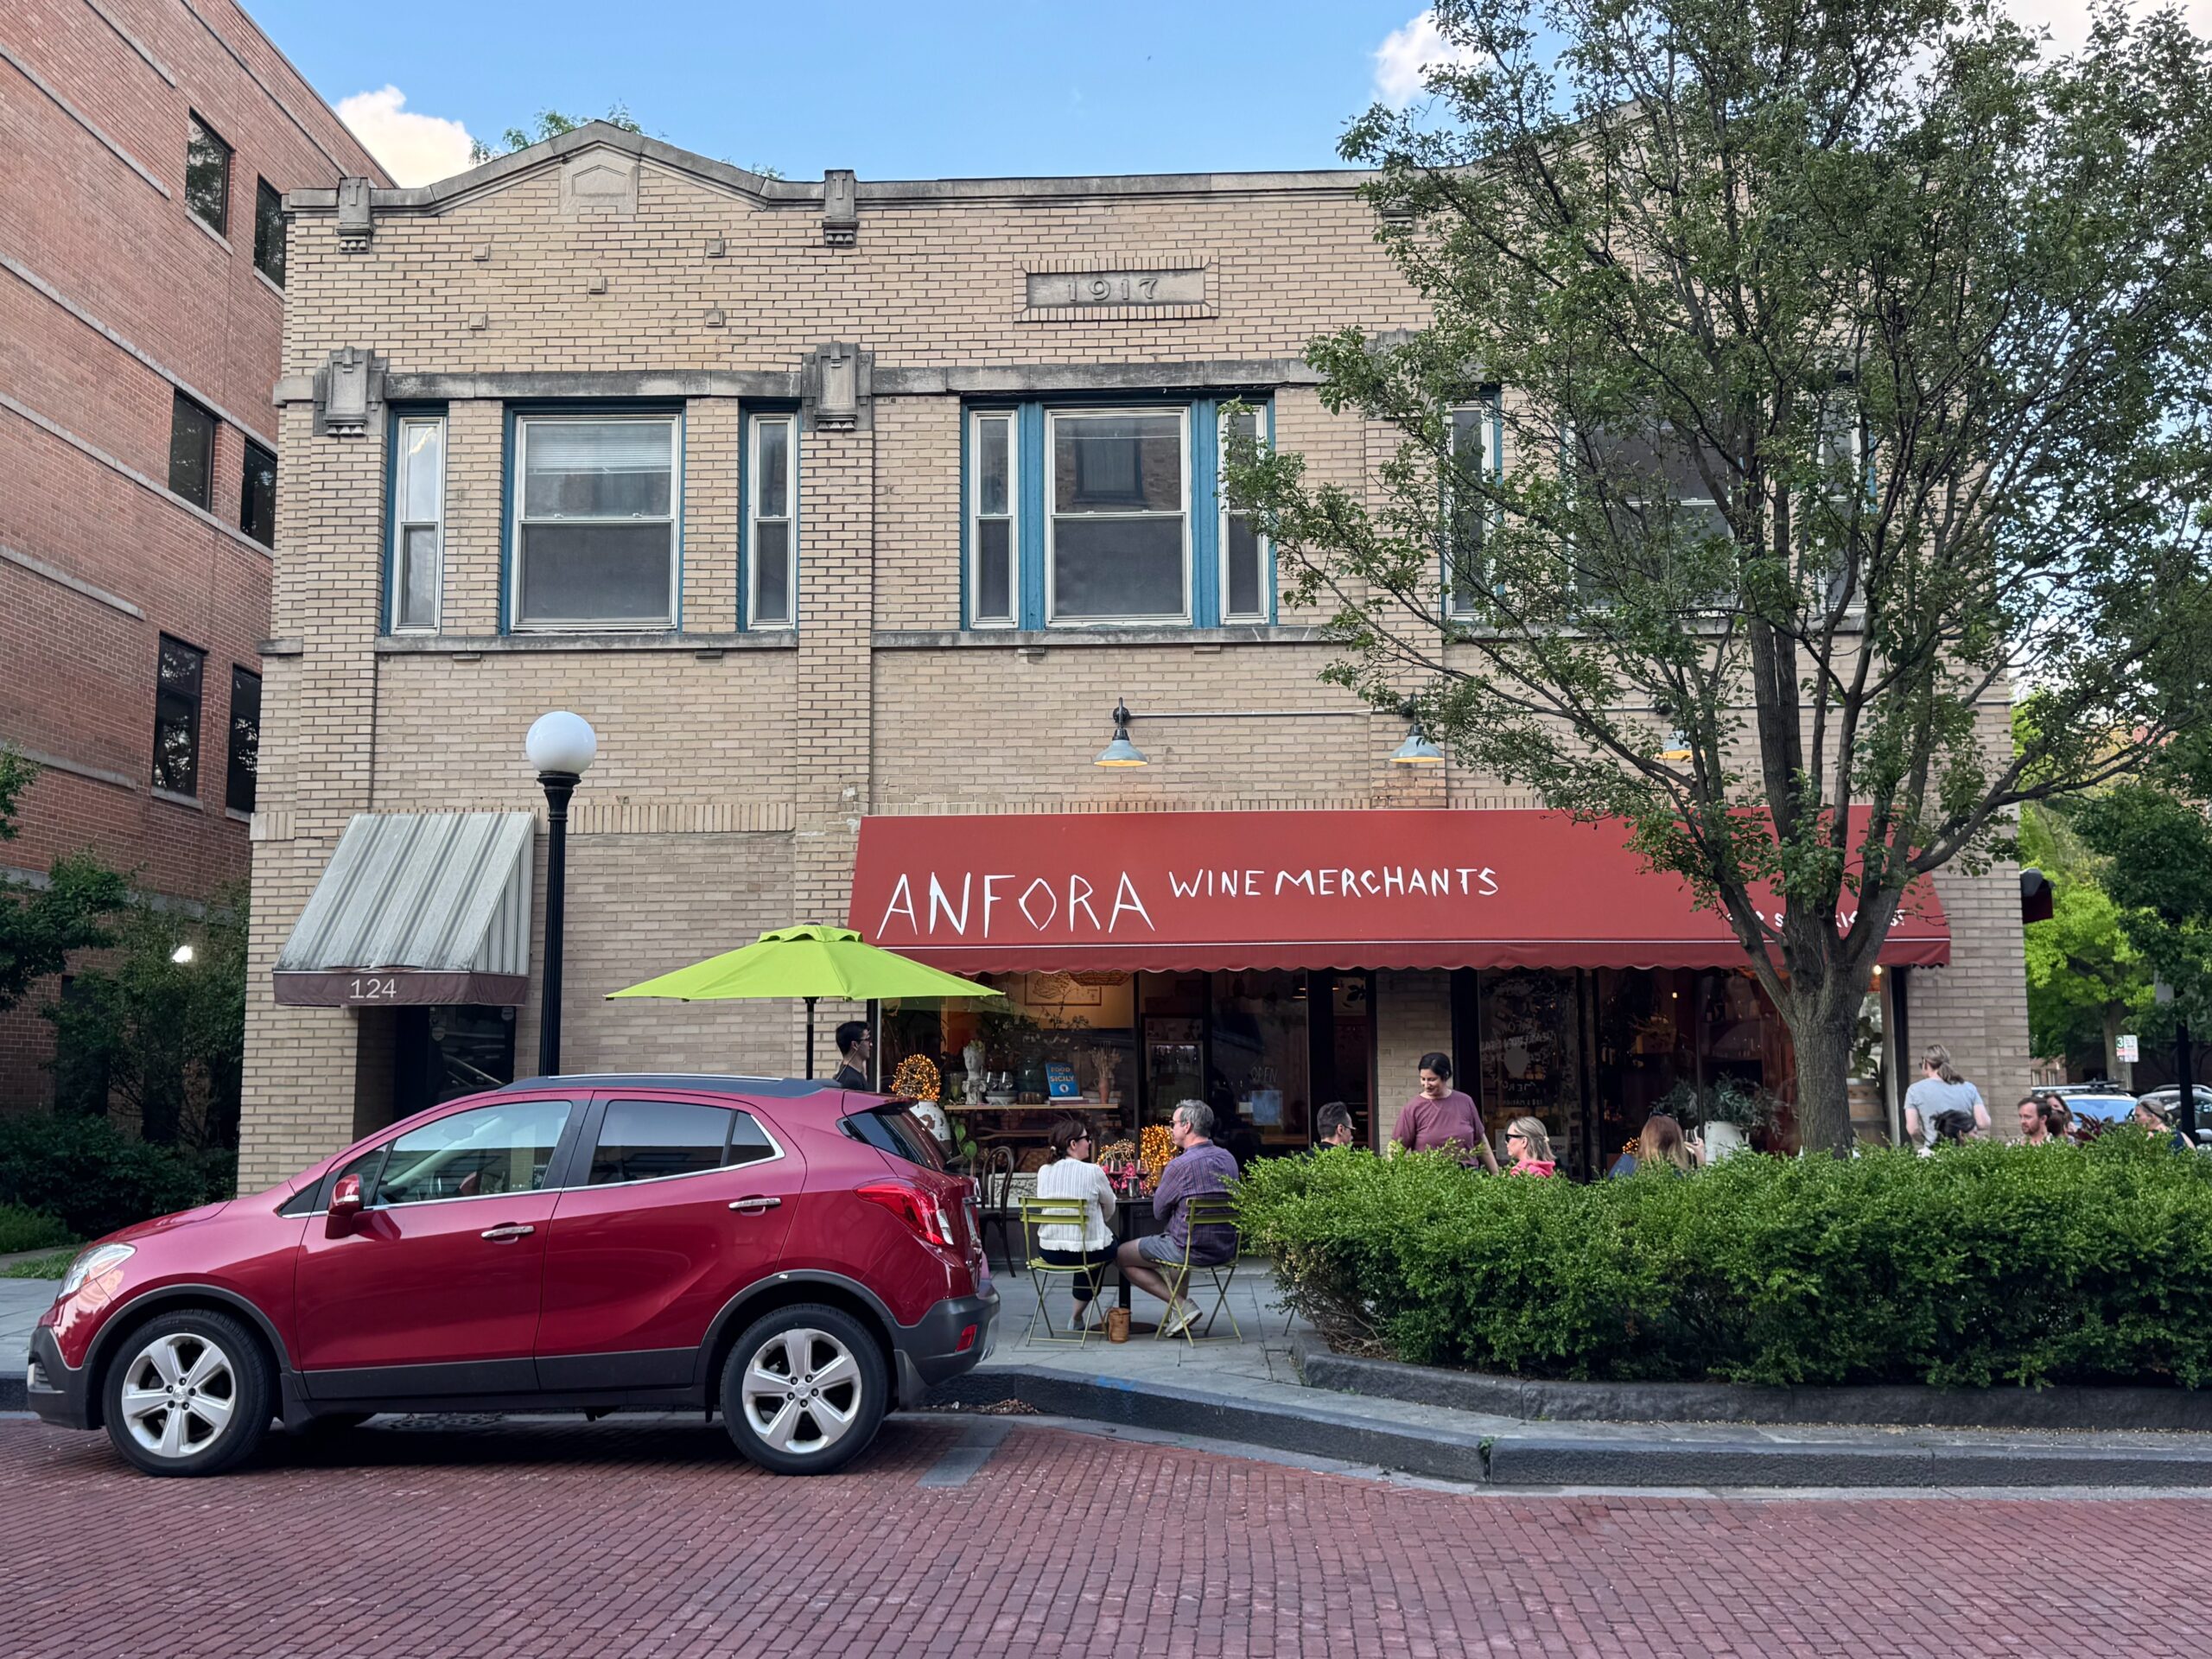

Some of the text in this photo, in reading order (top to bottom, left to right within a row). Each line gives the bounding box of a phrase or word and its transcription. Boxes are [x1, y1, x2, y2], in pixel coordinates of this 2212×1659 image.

[1067, 277, 1158, 302] 1917
[876, 866, 1500, 940] ANFORA WINE MERCHANTS
[349, 978, 397, 999] 124
